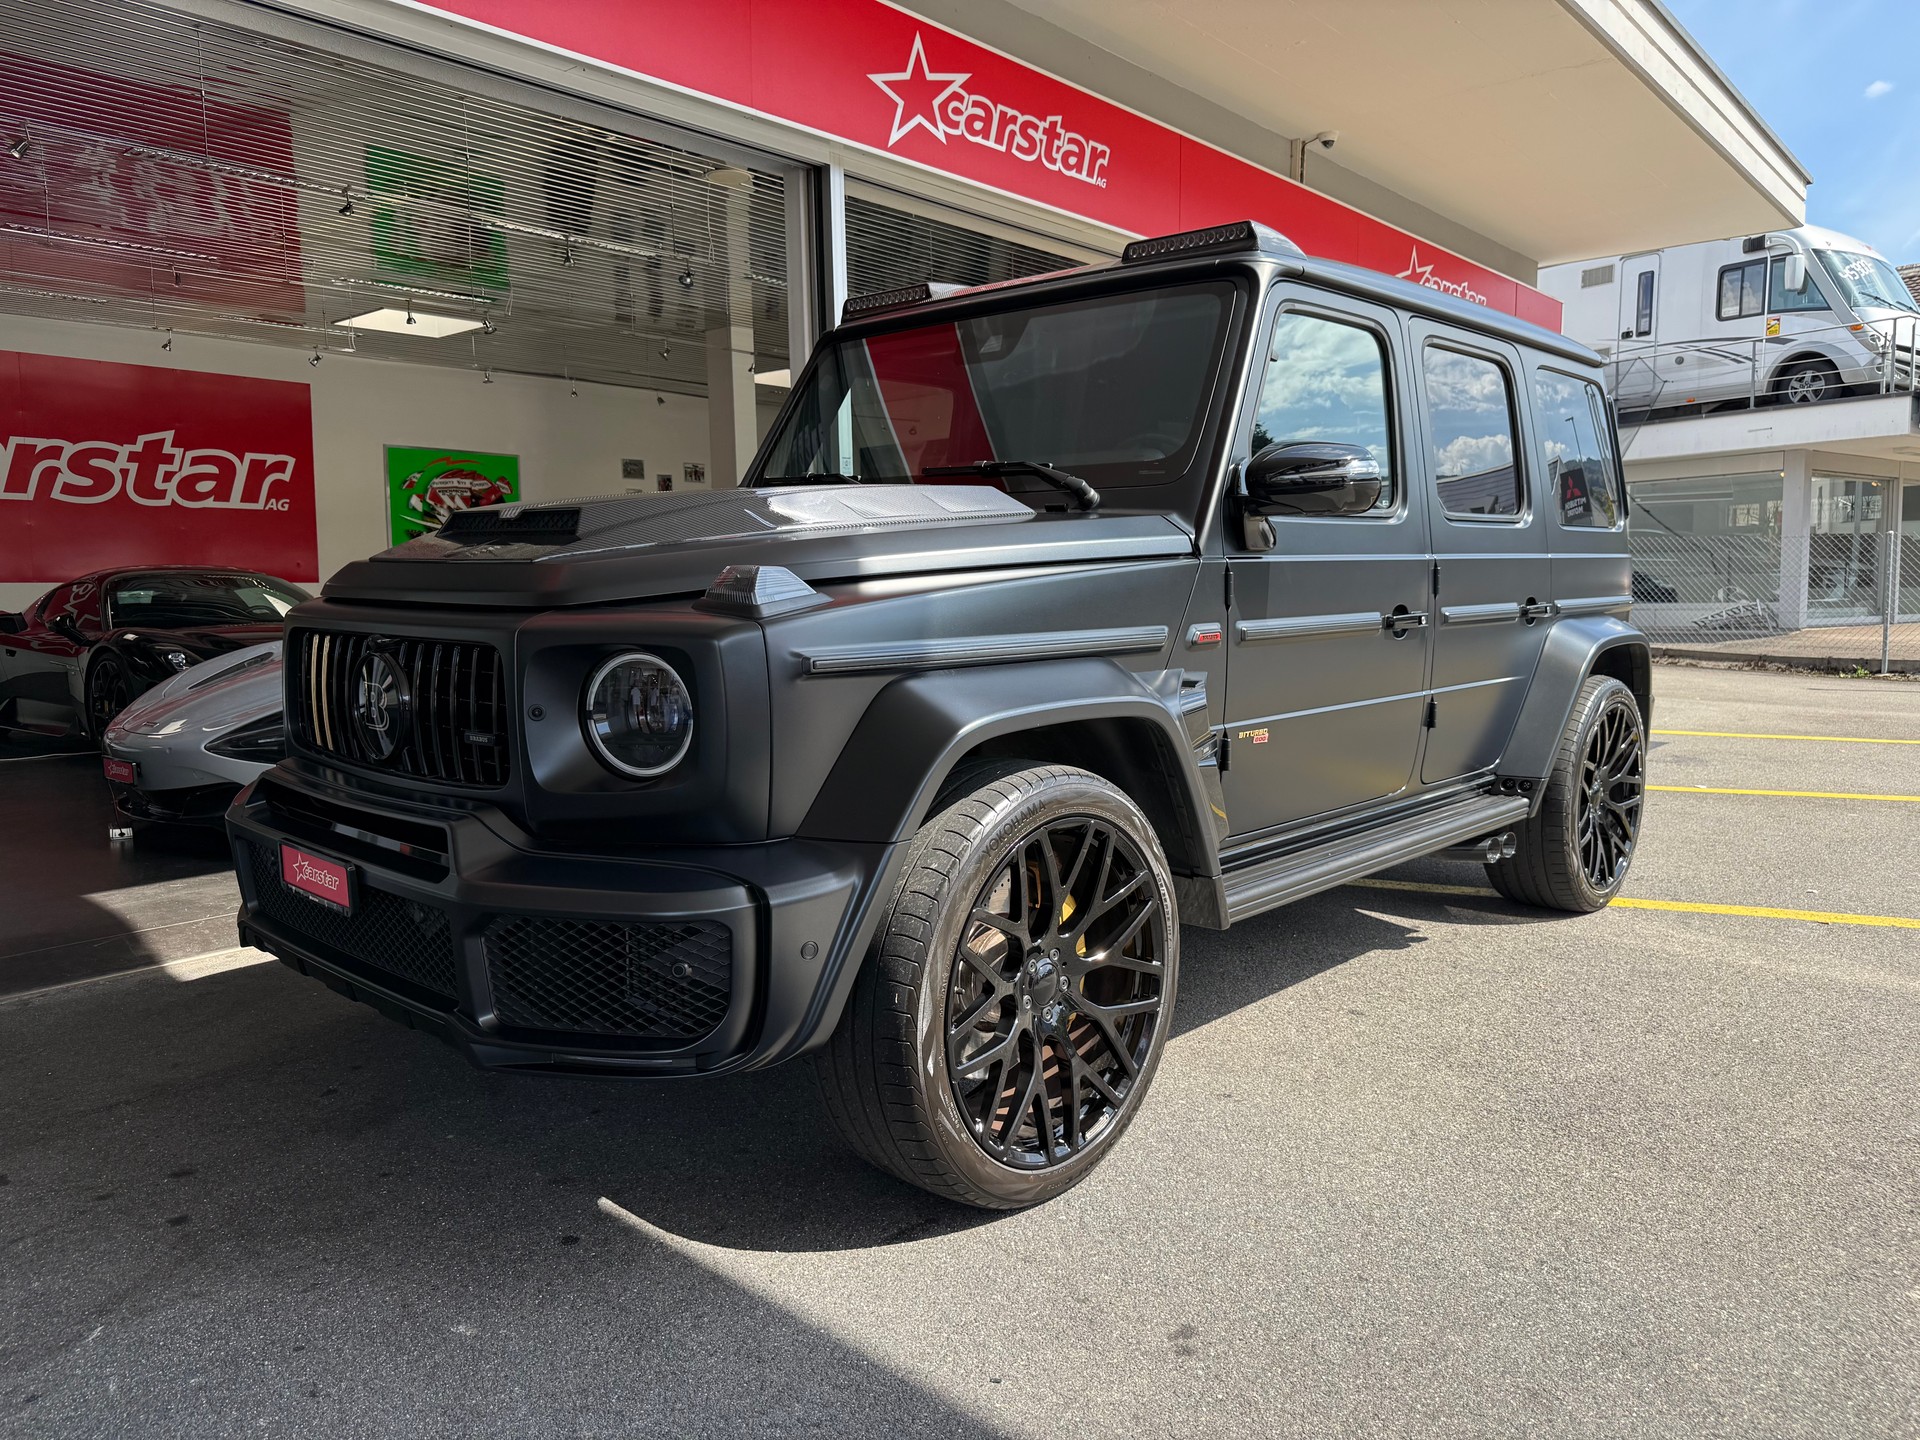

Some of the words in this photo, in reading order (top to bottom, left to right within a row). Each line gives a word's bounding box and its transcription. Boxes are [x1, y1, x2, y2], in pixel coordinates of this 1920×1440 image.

[936, 86, 1111, 185] carstar
[1096, 176, 1107, 188] AG
[0, 430, 296, 510] rstar
[264, 498, 290, 511] AG
[982, 800, 1046, 858] YOKOHAMA
[303, 865, 339, 890] carstar
